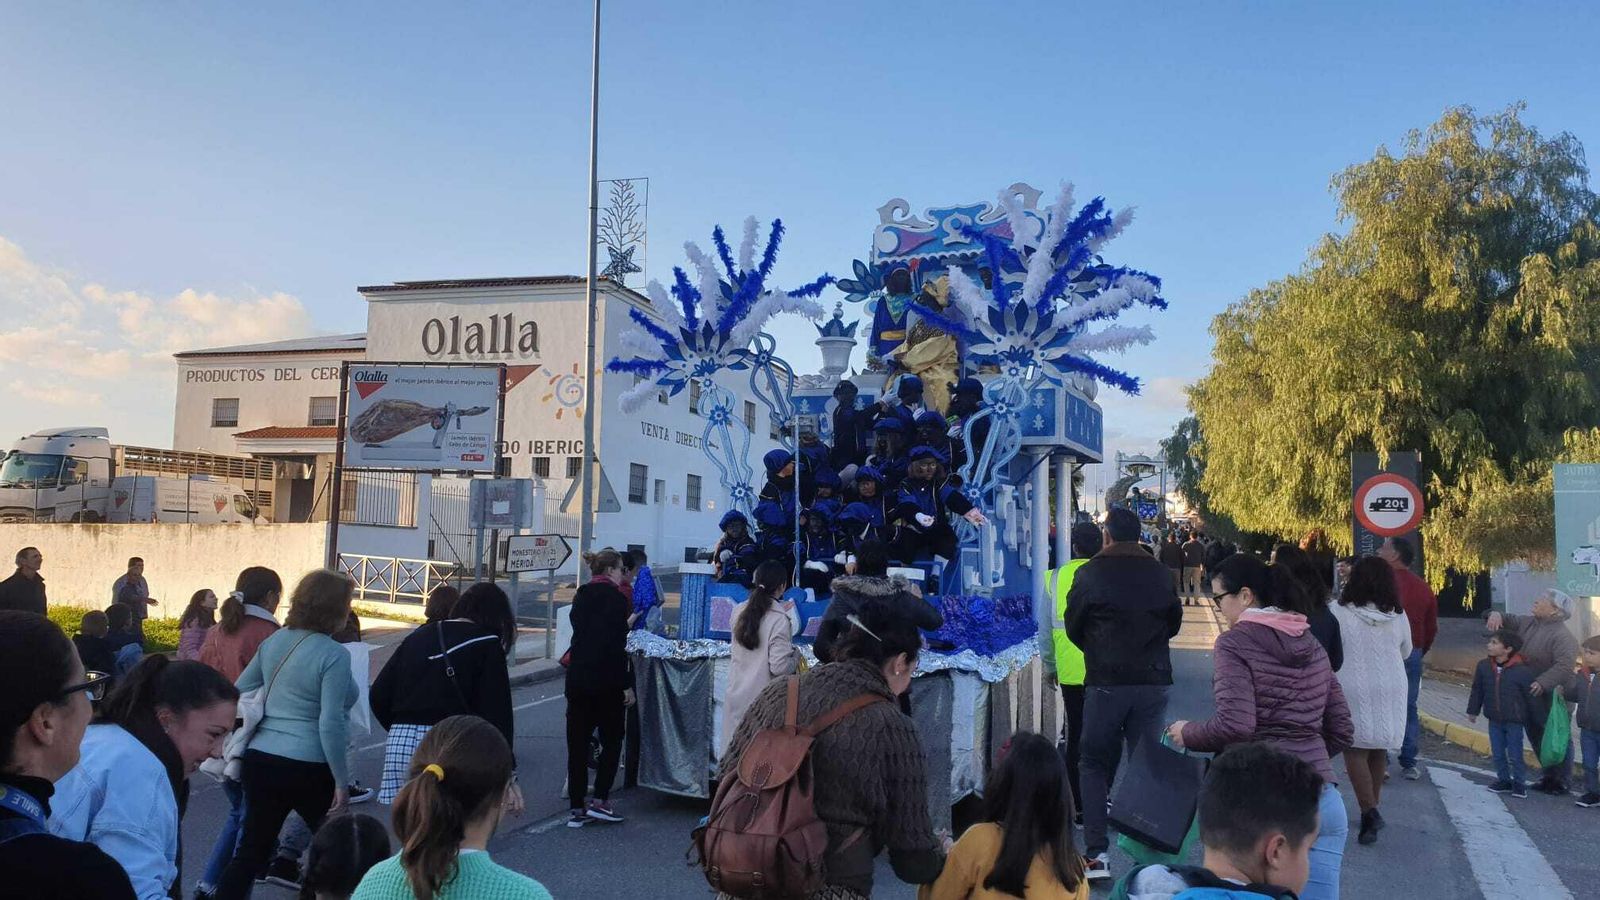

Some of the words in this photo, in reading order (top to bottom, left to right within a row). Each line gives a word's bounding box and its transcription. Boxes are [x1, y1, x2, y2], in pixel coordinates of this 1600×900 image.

[421, 312, 540, 356] Olalla
[186, 369, 265, 383] PRODUCTOS
[274, 368, 302, 381] DEL
[354, 370, 389, 383] Olalla
[640, 421, 670, 441] VENTA
[675, 431, 704, 449] DIRECT
[528, 440, 583, 454] IBERIC
[1384, 499, 1404, 508] 20t
